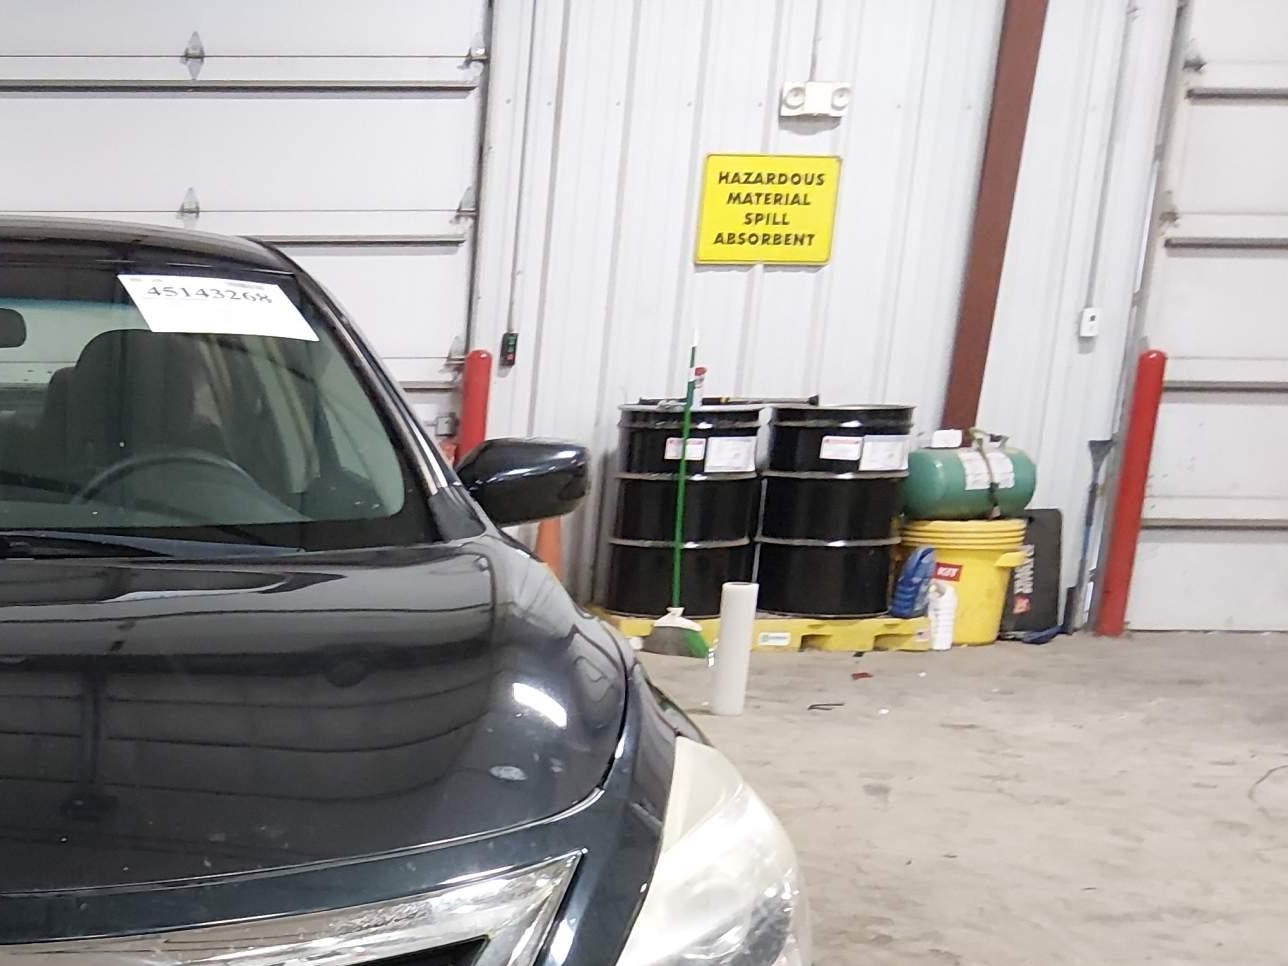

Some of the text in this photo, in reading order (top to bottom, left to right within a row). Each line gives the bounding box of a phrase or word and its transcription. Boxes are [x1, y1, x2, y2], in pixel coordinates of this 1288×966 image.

[718, 171, 825, 186] HAZARDOUS
[726, 192, 811, 205] MATERIAL
[743, 212, 790, 225] SPILL
[713, 232, 816, 246] ABSORBENT
[146, 286, 273, 304] 45143268
